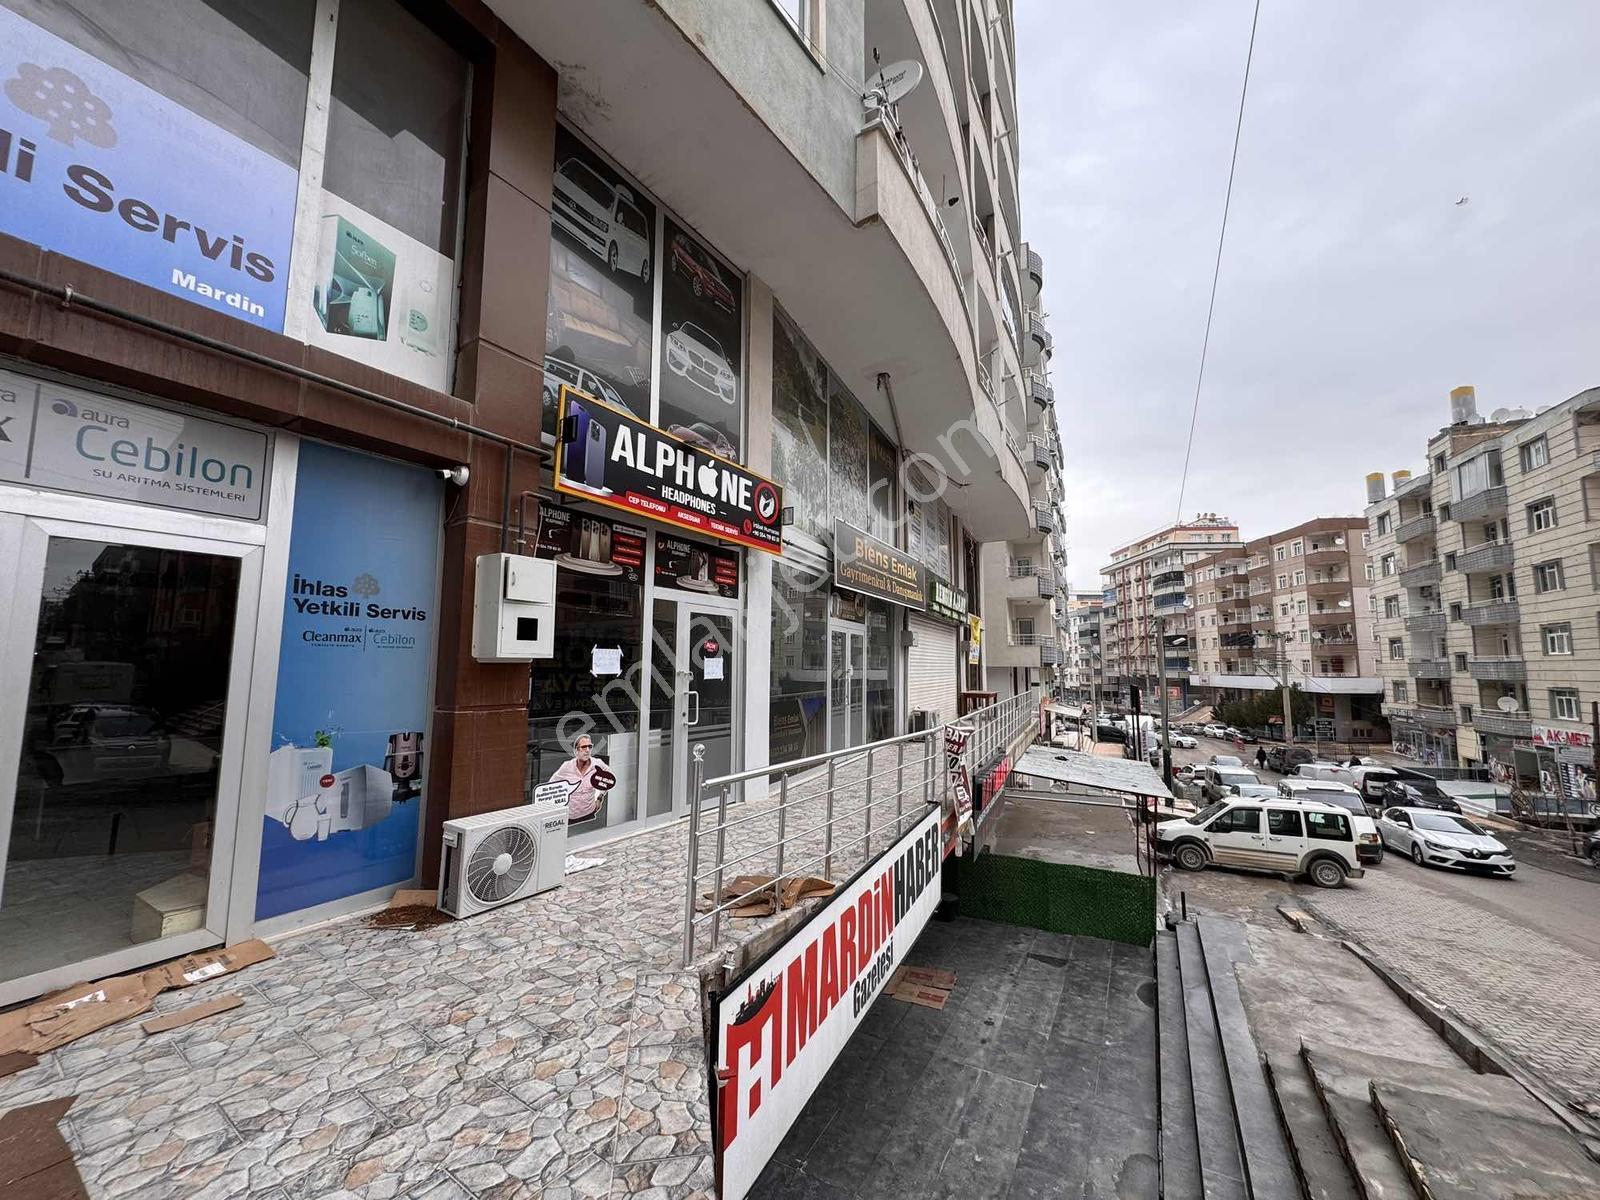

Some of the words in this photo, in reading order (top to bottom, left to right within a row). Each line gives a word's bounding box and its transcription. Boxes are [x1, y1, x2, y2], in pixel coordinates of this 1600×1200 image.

[63, 164, 276, 282] Servis
[171, 267, 266, 319] Mardin
[81, 408, 130, 429] aura
[76, 424, 253, 489] Cebilon
[92, 468, 114, 479] SU
[116, 473, 171, 489] ARITMA
[628, 495, 640, 505] CEP
[661, 484, 716, 515] HEADPHONES
[855, 537, 889, 569] Biens
[891, 559, 918, 581] Emlak
[839, 561, 886, 588] Gayrimenkul
[886, 582, 892, 592] &
[292, 597, 360, 617] Yetkili
[366, 603, 427, 621] Servis
[303, 630, 362, 643] Cleanmax
[373, 632, 415, 645] Cebilon
[544, 819, 565, 829] REGAL
[853, 936, 894, 1019] Gazetesi
